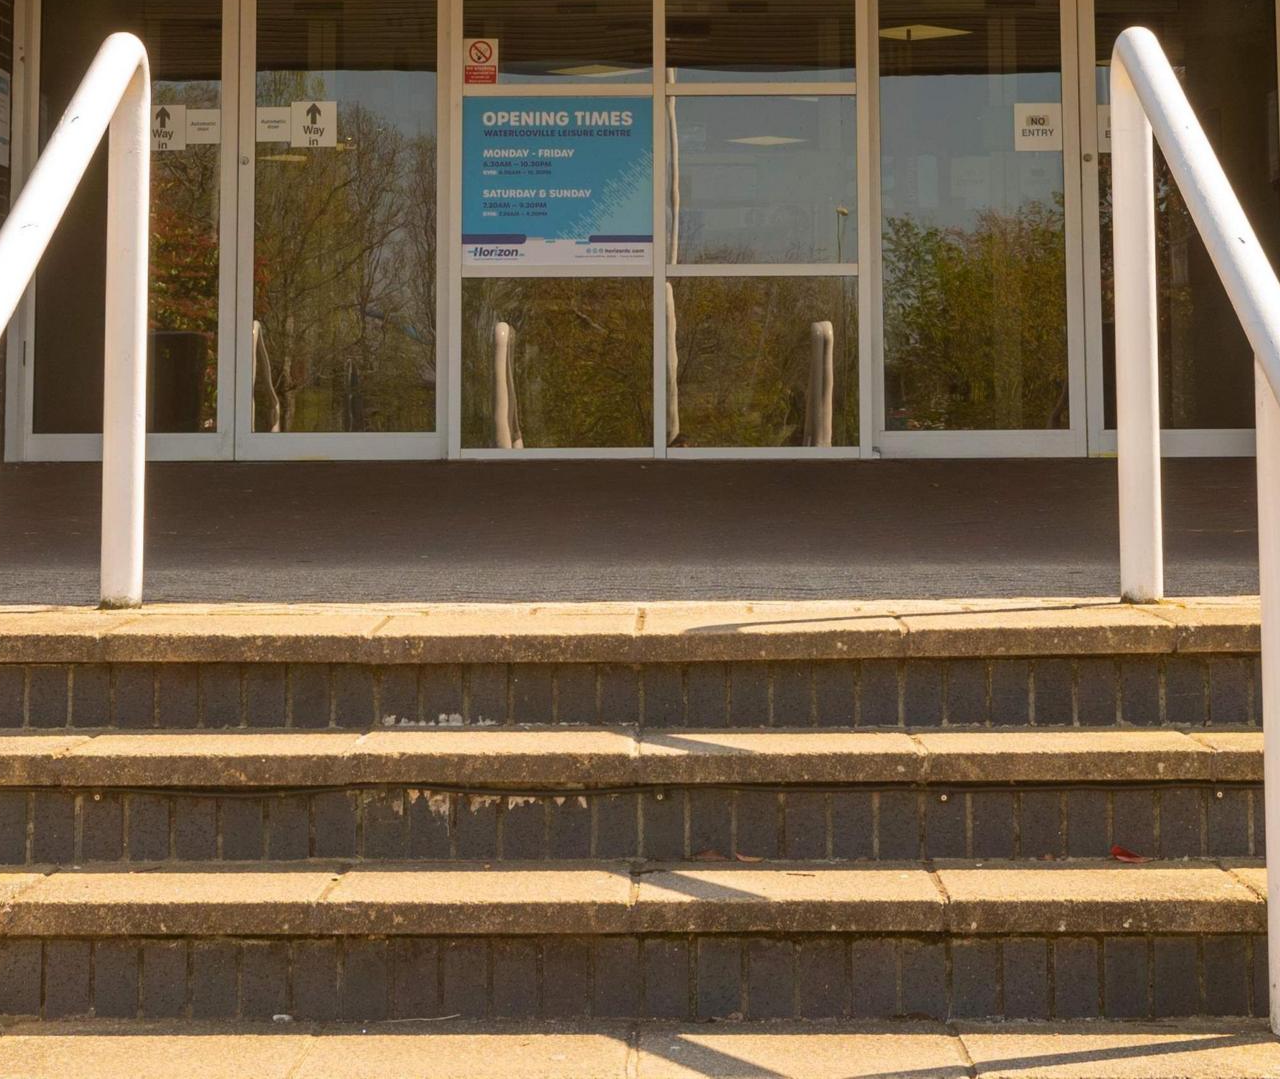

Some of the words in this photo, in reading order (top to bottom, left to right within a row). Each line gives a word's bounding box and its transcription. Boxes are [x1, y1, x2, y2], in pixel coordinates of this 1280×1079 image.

[482, 111, 569, 126] OPENING
[574, 111, 633, 126] TIMES
[1030, 117, 1046, 126] NO
[152, 128, 174, 140] Way
[303, 125, 325, 137] Way
[484, 129, 555, 137] WATERLOOVILLE
[558, 129, 594, 137] LEISURE
[596, 129, 631, 137] CENTRE
[1021, 128, 1054, 137] ENTRY
[158, 140, 168, 149] in
[308, 136, 319, 146] in
[483, 149, 529, 158] MONDAY
[538, 149, 575, 158] FRIDAY
[483, 189, 536, 198] SATURDAY
[539, 189, 547, 198] &
[549, 189, 592, 198] SUNDAY
[468, 246, 518, 257] Horizon
